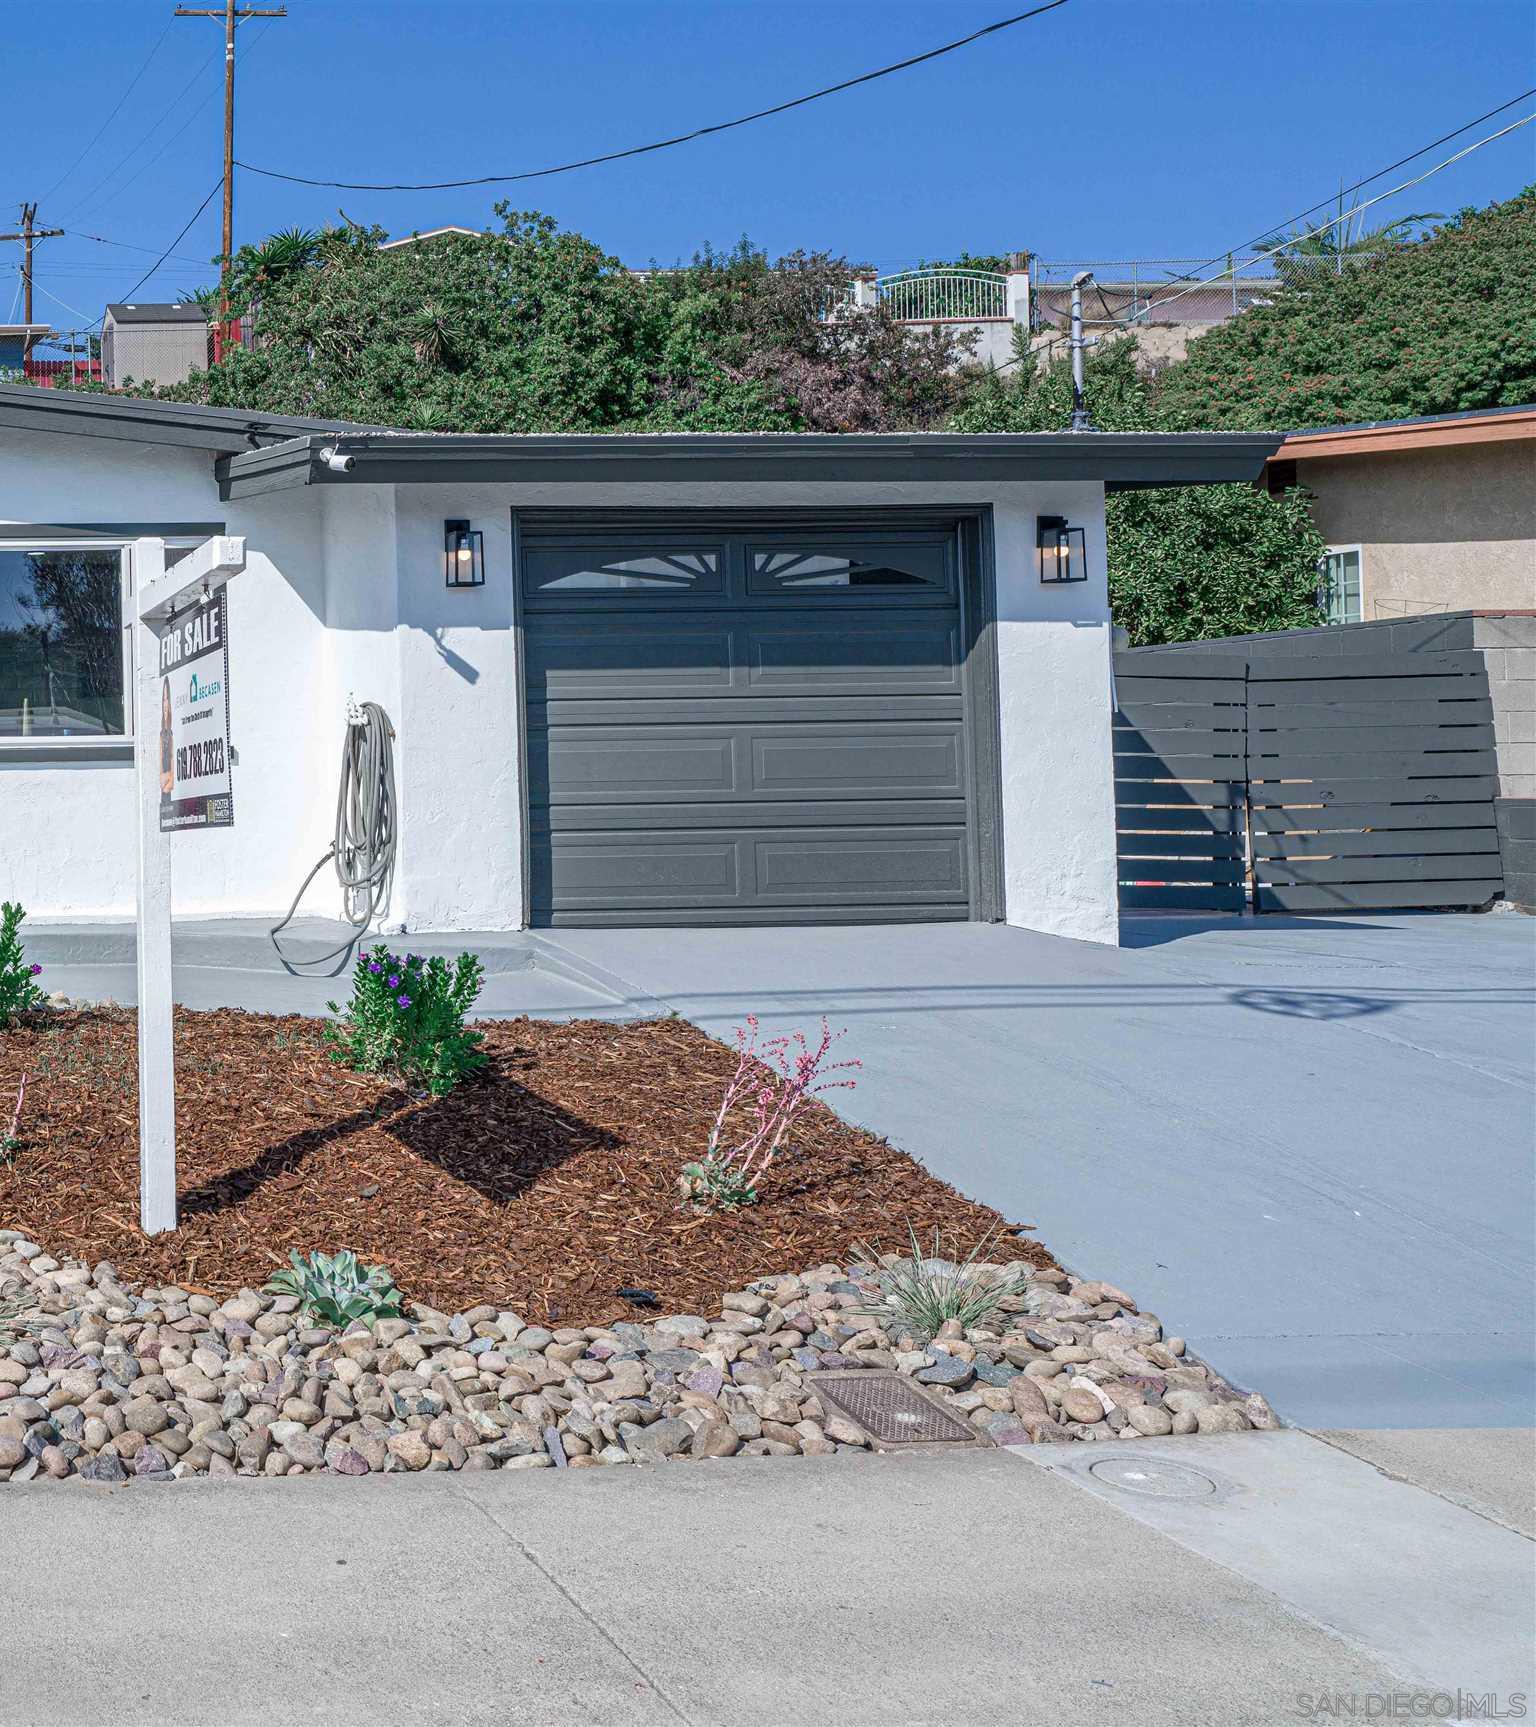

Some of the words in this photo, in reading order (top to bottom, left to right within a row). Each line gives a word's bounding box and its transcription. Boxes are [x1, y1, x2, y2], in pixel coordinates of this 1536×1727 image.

[161, 628, 182, 670] FOR
[184, 607, 220, 657] SALE
[175, 737, 225, 782] 619.788.2823
